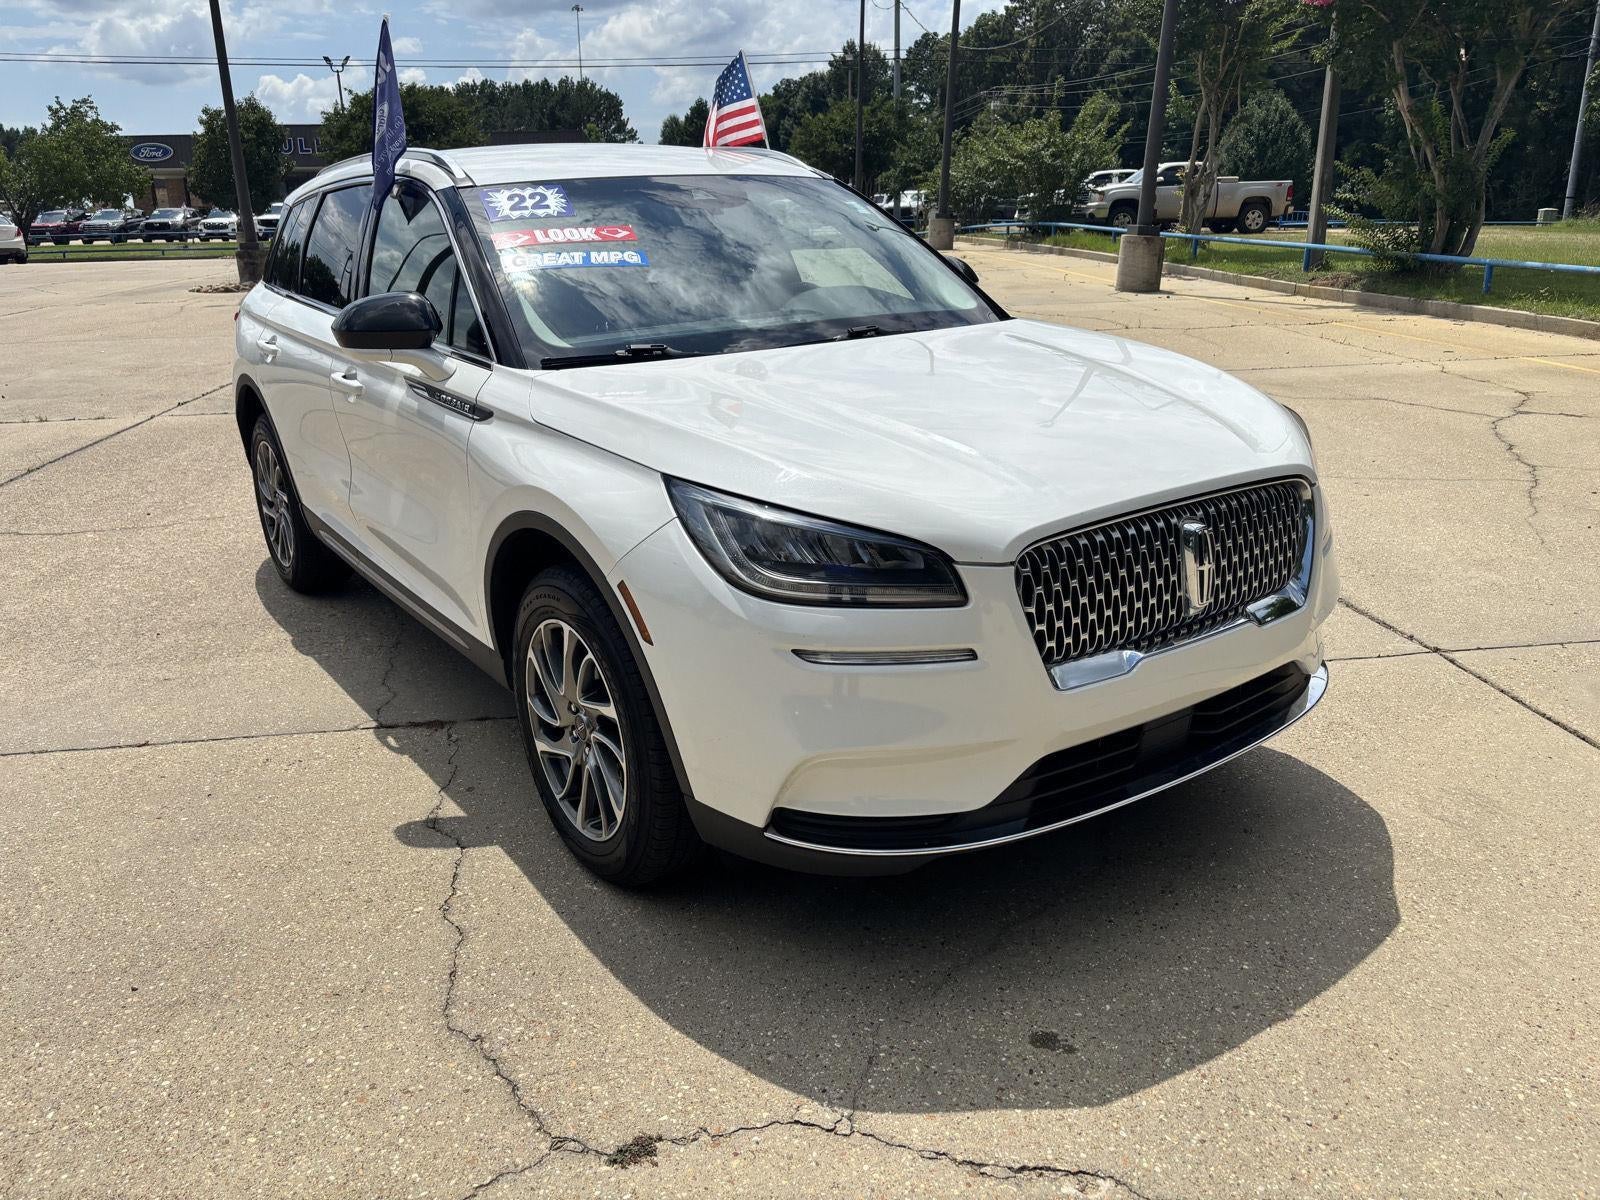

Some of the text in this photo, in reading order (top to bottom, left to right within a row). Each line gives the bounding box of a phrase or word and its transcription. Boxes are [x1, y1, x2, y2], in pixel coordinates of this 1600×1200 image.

[138, 146, 164, 158] Ford
[506, 191, 551, 212] 22
[533, 227, 601, 243] LOOK
[511, 250, 642, 268] GREAT MPG
